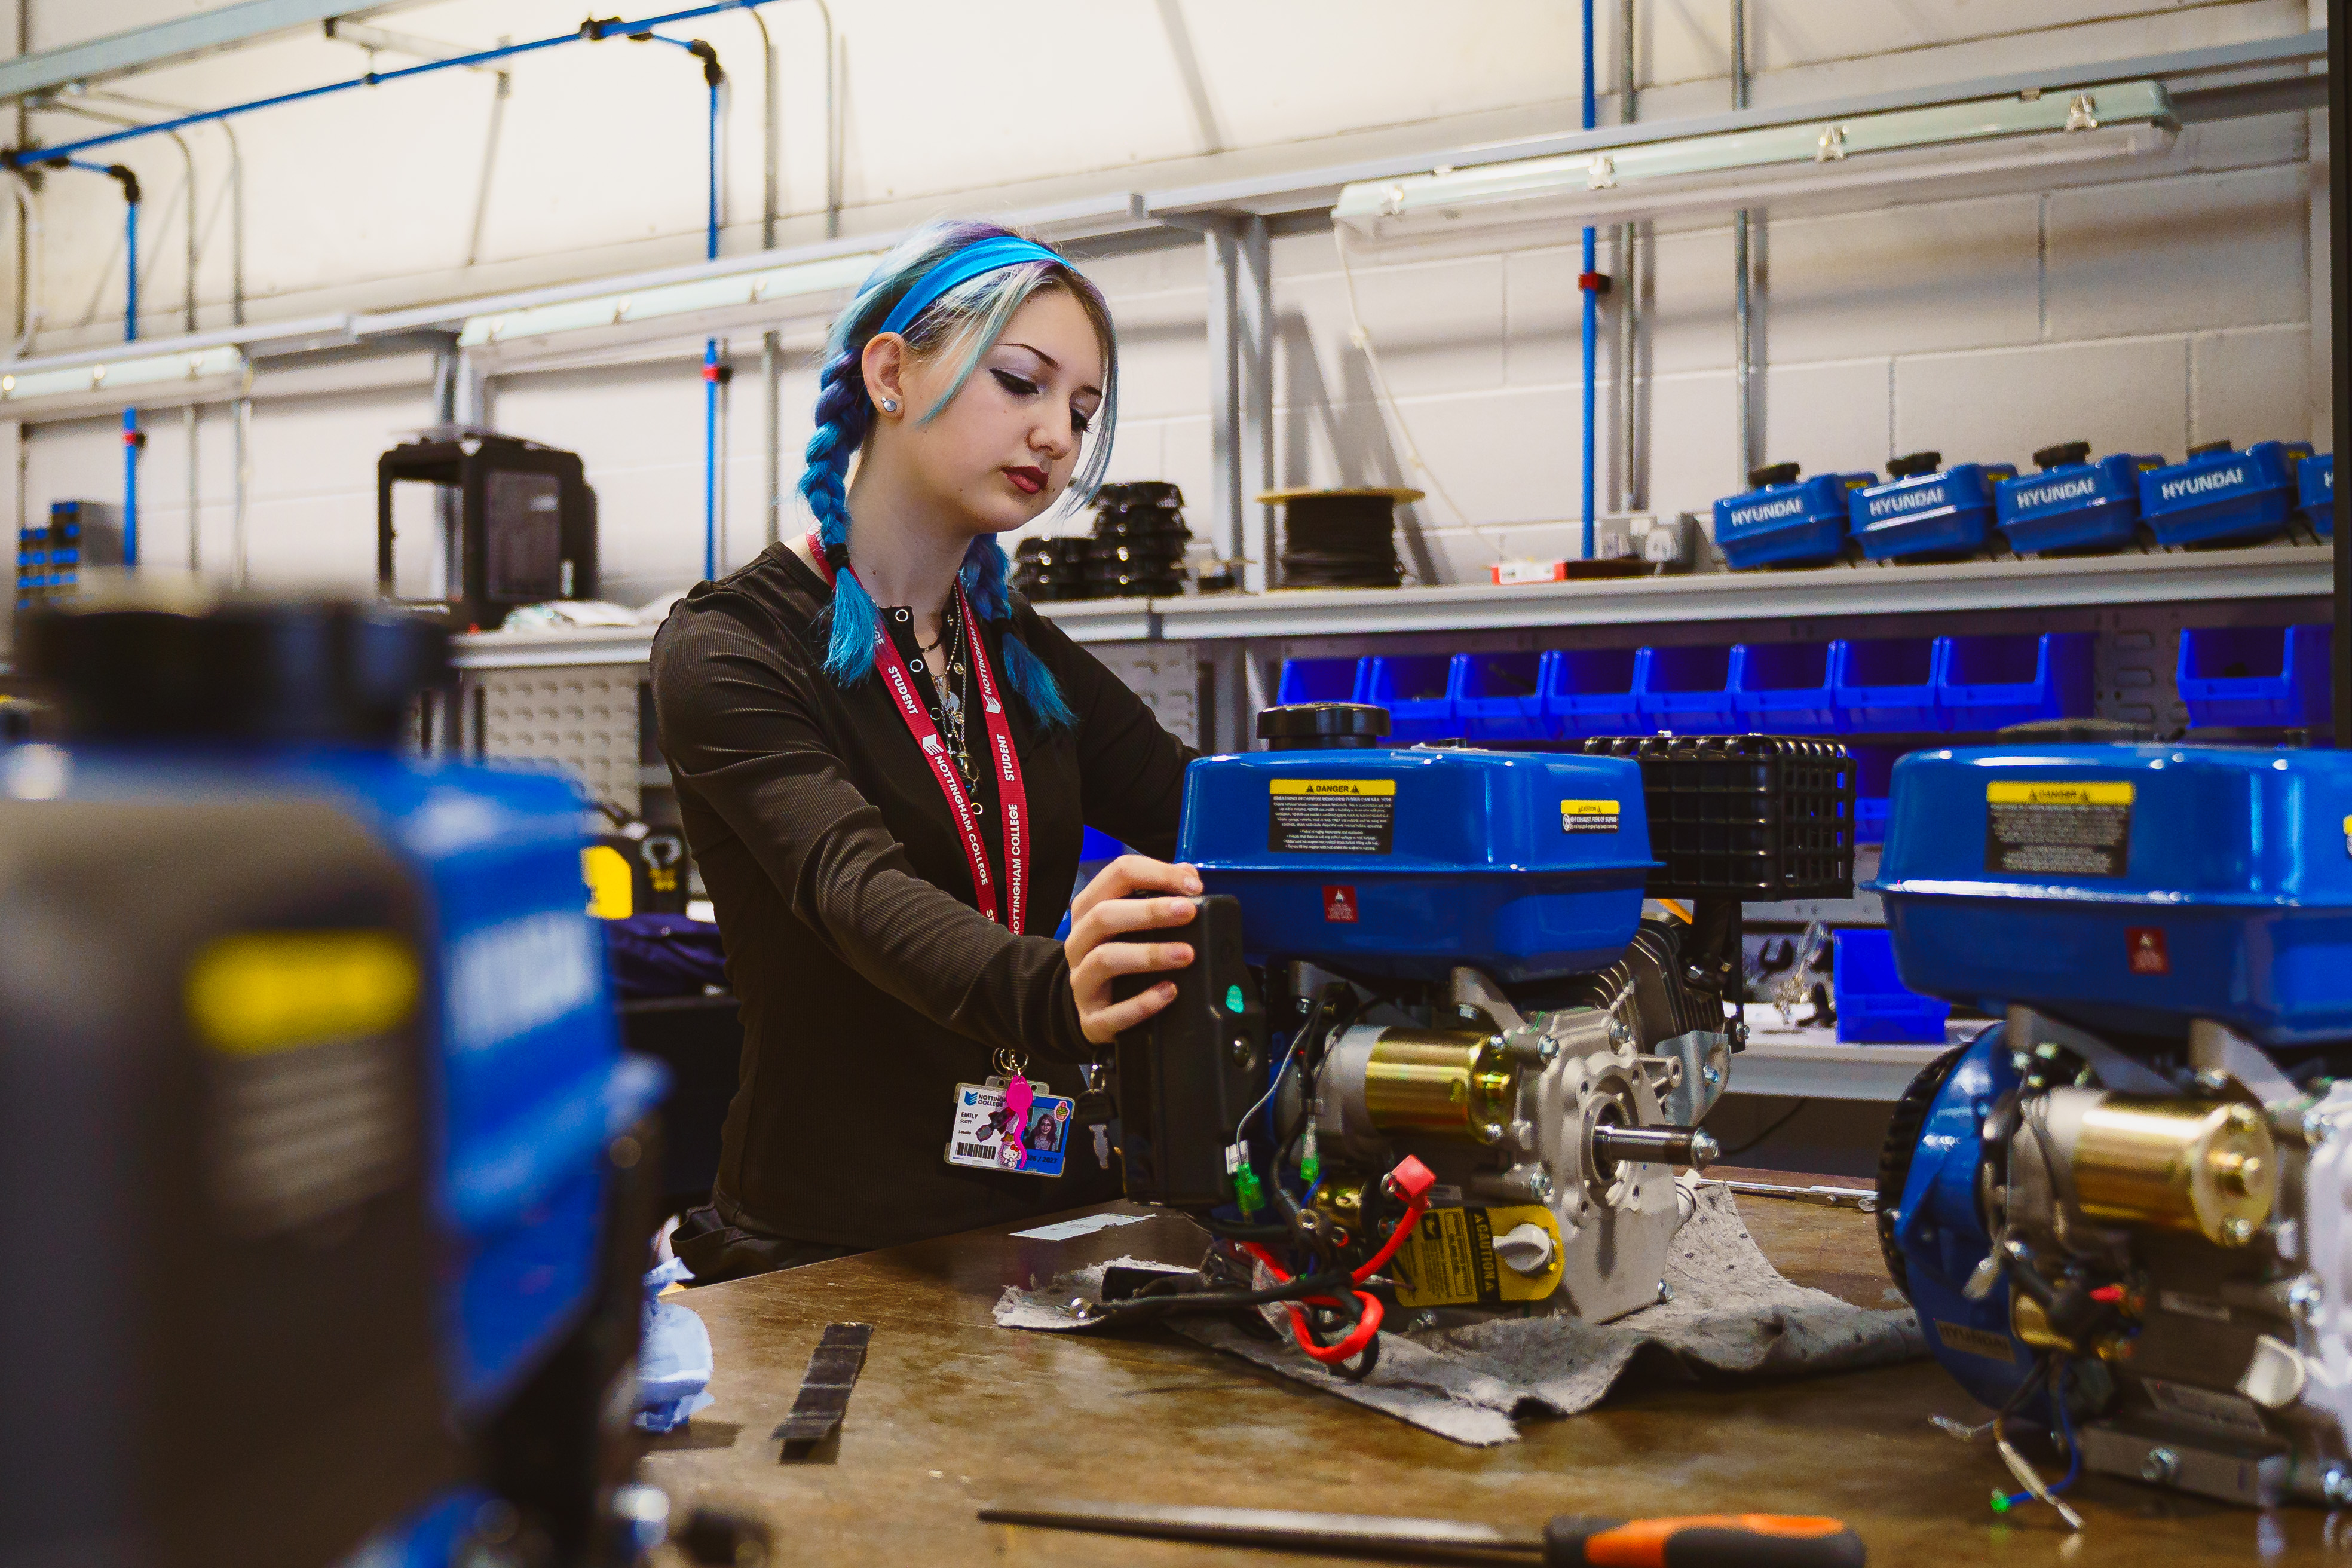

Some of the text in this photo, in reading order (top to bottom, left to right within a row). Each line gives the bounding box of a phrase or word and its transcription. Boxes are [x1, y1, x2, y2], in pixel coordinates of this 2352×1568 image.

[1869, 486, 1944, 516] HYUNDAI
[2017, 478, 2096, 509] HYUNDAI
[2161, 467, 2243, 500] HYUNDAI
[1731, 496, 1803, 526] HYUNDAI
[970, 626, 992, 694] NOTTINGHAM
[887, 666, 918, 715] STUDENT
[997, 734, 1015, 782] STUDENT
[935, 755, 988, 886] NOTTINGHAM COLLEGE
[1008, 804, 1021, 855] COLLEGE
[978, 1094, 1007, 1103] NOTTINGH
[1476, 1224, 1495, 1283] CAUTION
